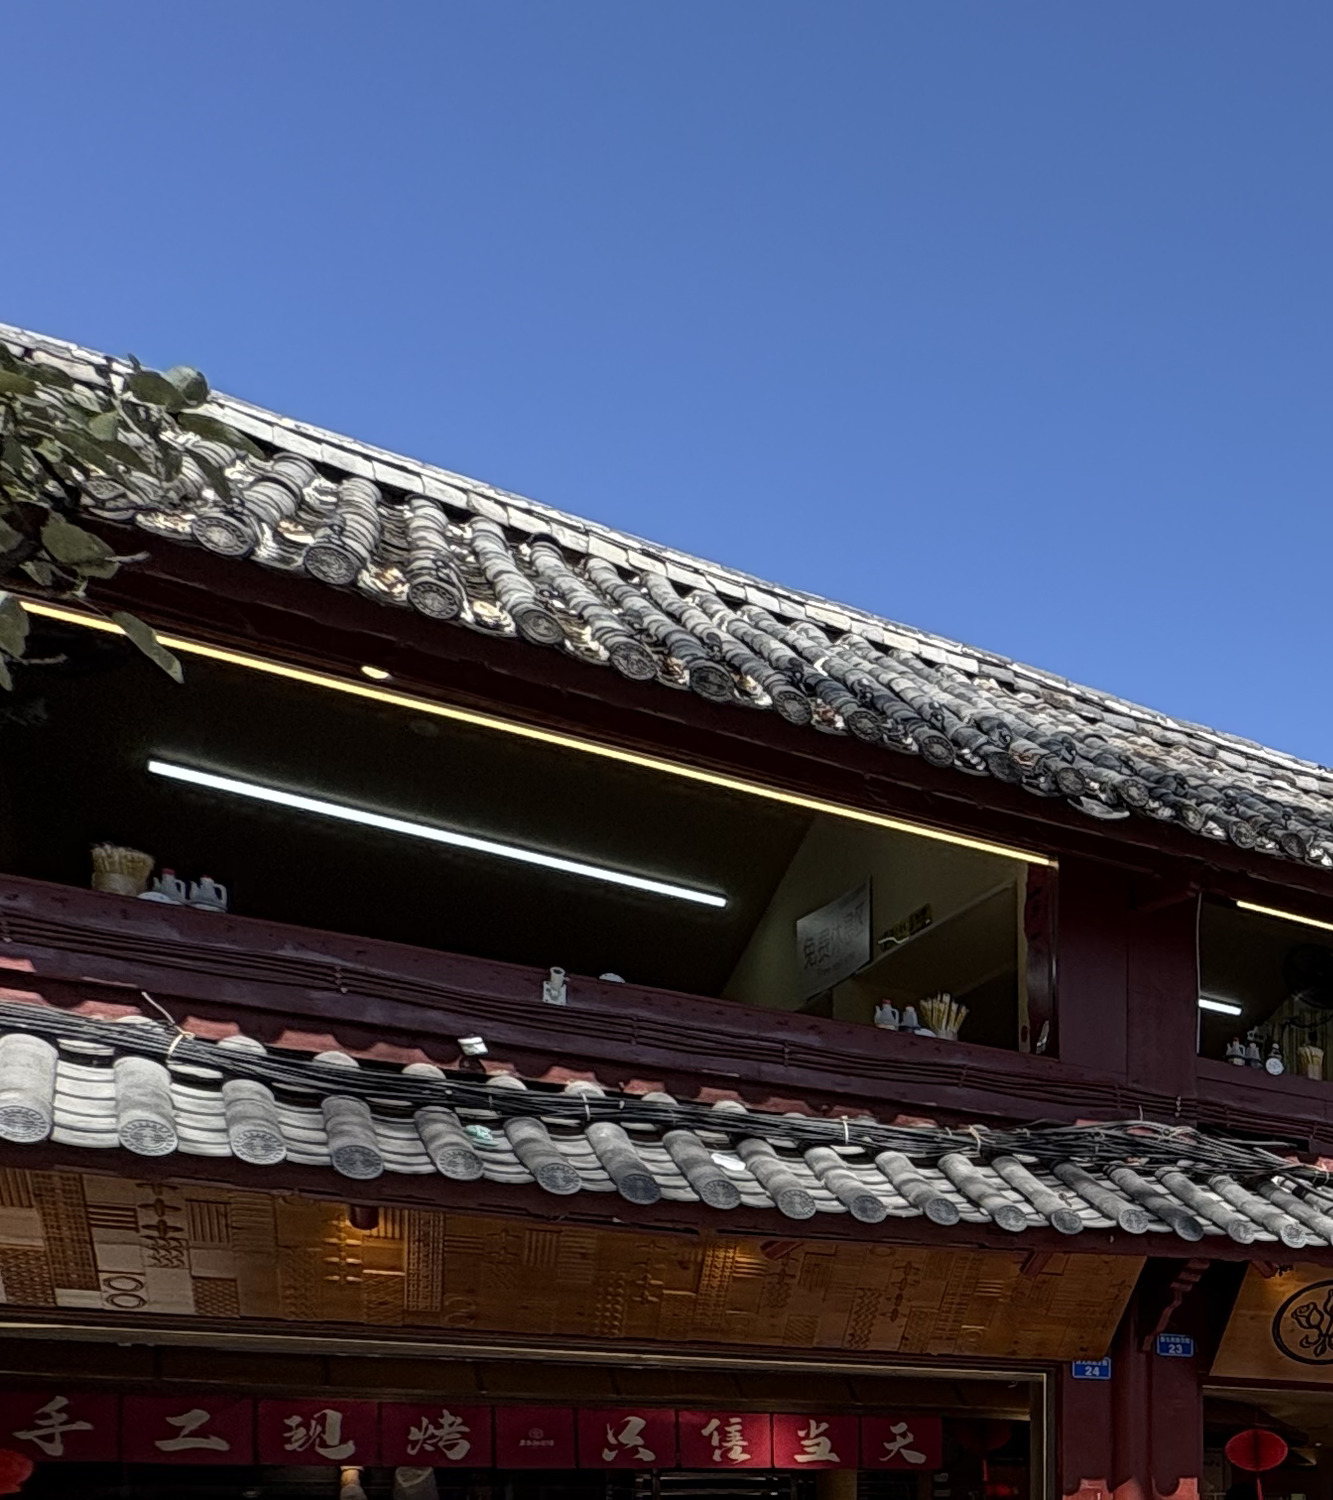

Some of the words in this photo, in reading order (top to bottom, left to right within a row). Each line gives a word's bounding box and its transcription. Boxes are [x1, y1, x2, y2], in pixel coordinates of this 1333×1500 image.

[1168, 1344, 1183, 1354] 23
[1085, 1366, 1100, 1376] 24
[12, 1396, 471, 1460] 手工现烤
